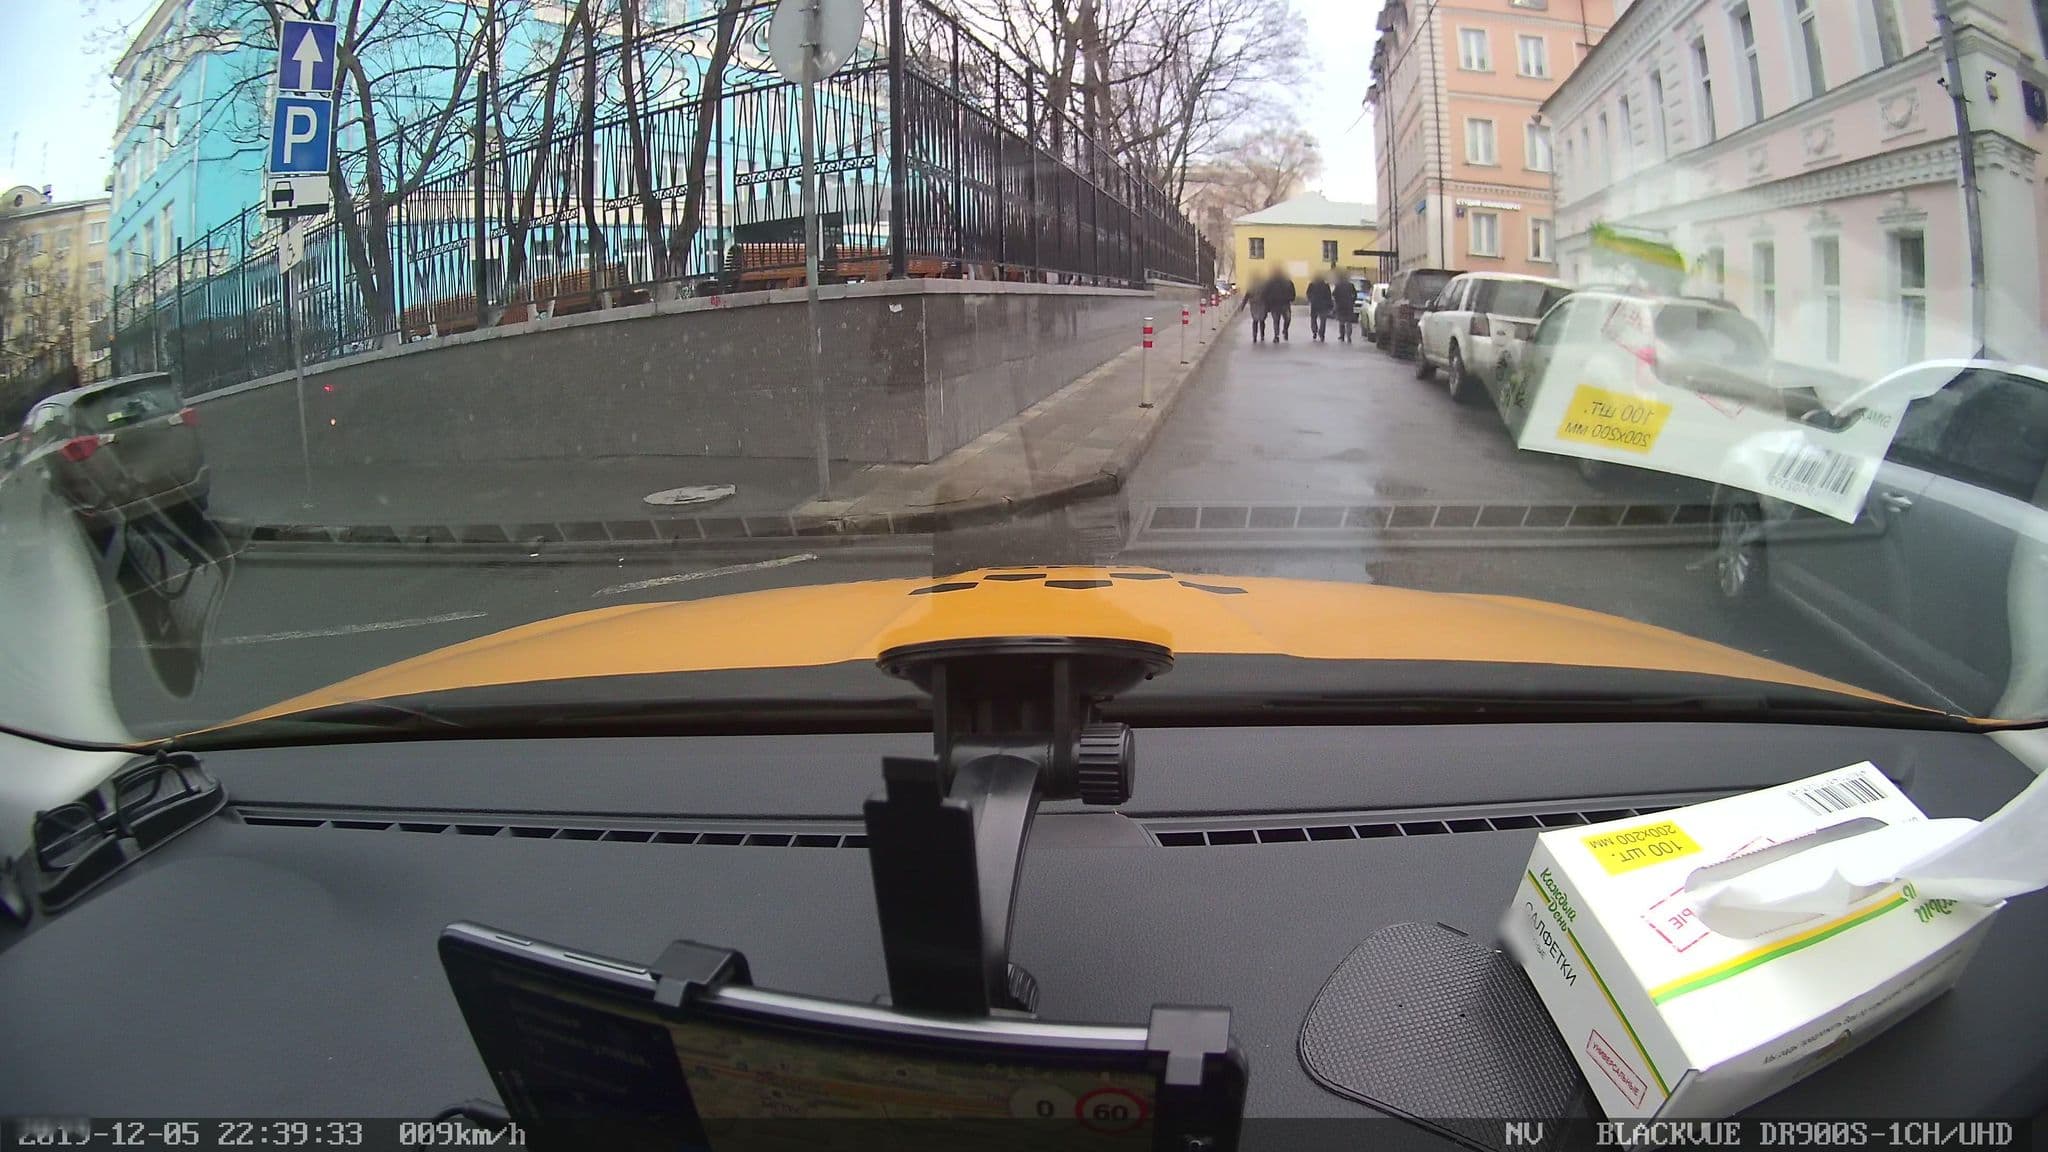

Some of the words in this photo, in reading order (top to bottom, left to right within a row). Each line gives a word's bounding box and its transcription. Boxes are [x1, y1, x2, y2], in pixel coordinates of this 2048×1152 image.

[283, 106, 318, 164] P
[1648, 840, 1684, 857] 100
[1540, 868, 1578, 923] Каждый
[1548, 900, 1568, 932] День
[1525, 901, 1578, 987] САЛФЕТКИ
[1036, 1099, 1055, 1117] 0
[1093, 1103, 1128, 1121] 60
